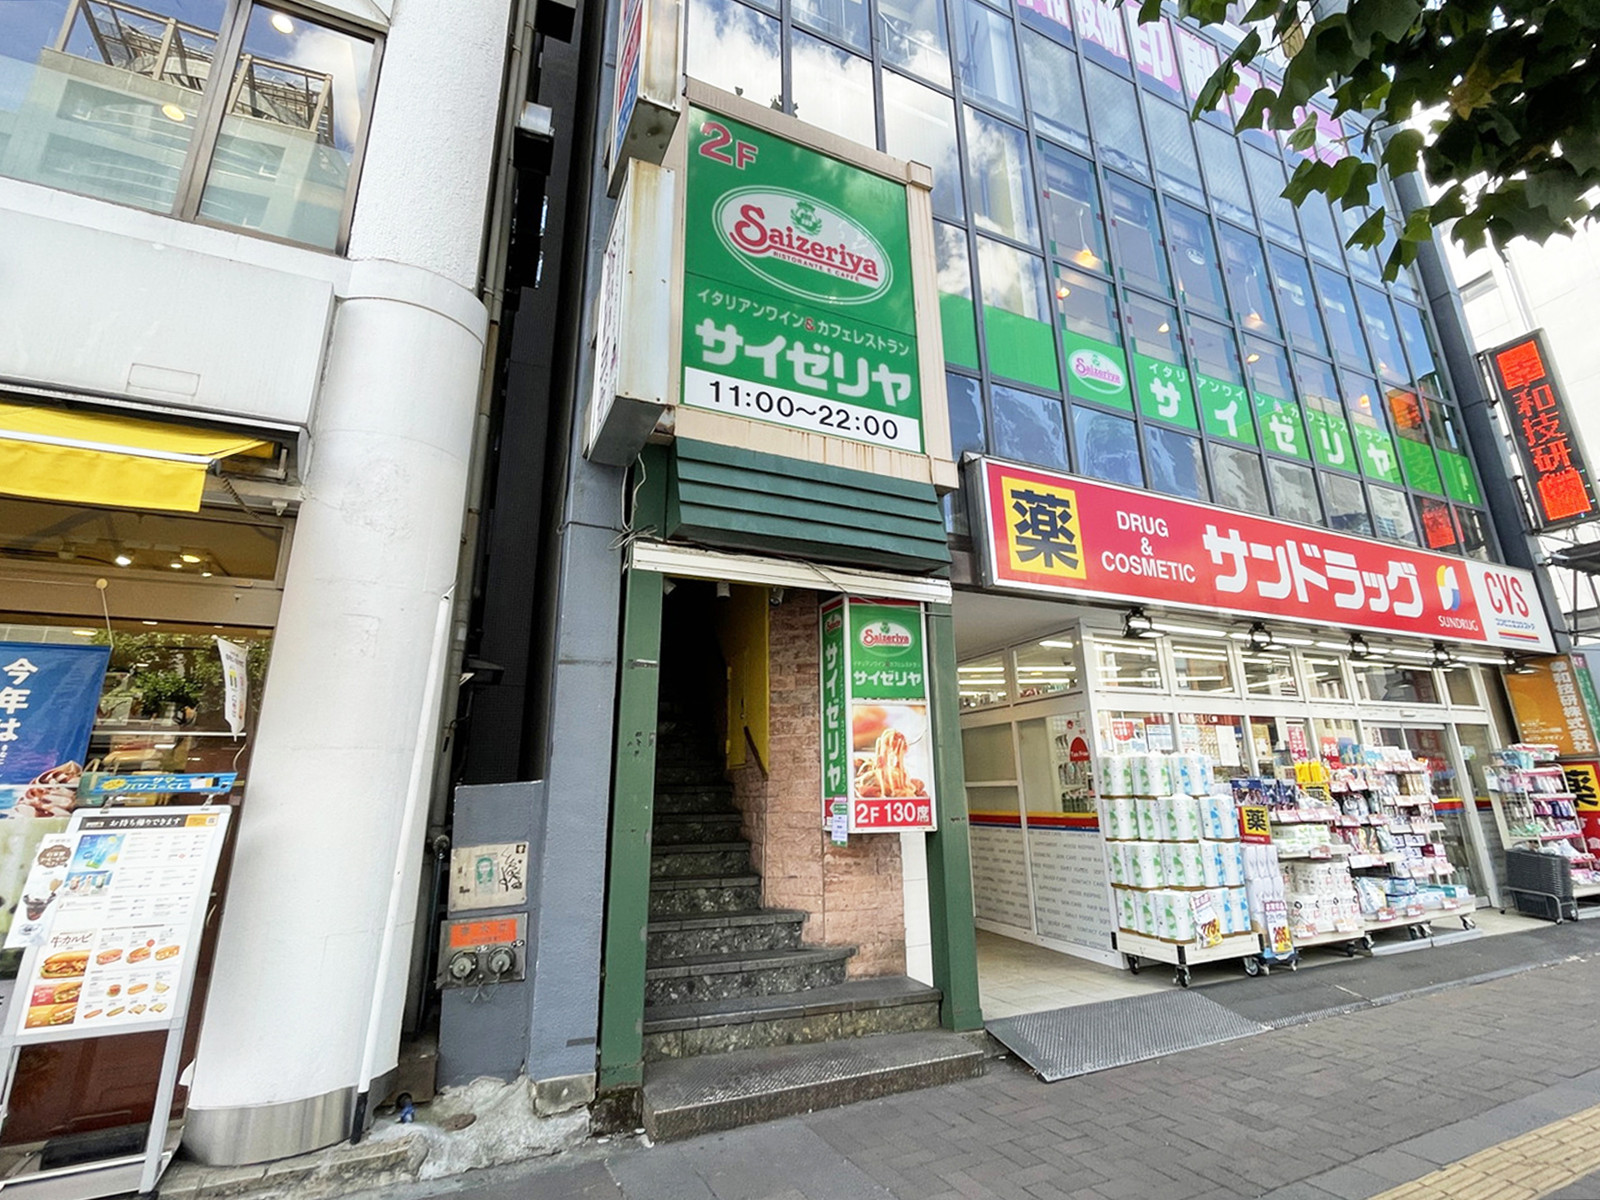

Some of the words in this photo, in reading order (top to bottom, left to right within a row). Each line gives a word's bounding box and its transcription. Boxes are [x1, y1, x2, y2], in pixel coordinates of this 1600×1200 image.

[699, 121, 759, 170] 2F
[729, 204, 879, 284] Saizeriya
[773, 251, 823, 270] RISTORANTE
[697, 289, 910, 356] イタリアンワイン&カフェレストラン
[695, 318, 911, 407] サイゼリヤ
[1150, 377, 1391, 477] サイゼリヤ
[1011, 488, 1079, 570] 薬
[1116, 511, 1169, 538] DRUG
[1141, 539, 1153, 556] &
[1101, 554, 1196, 584] COSMETIC
[1203, 524, 1424, 617] サンドラッグ
[1484, 571, 1529, 618] CVS
[1438, 615, 1479, 631] SUNDRUG
[853, 671, 922, 687] サイゼリヤ
[825, 643, 842, 792] サイゼリヤ
[109, 818, 182, 828] お持ち帰りできます
[856, 803, 880, 824] 2F
[884, 802, 930, 824] 130席
[1245, 809, 1267, 831] 薬
[50, 932, 94, 948] 牛カルビ
